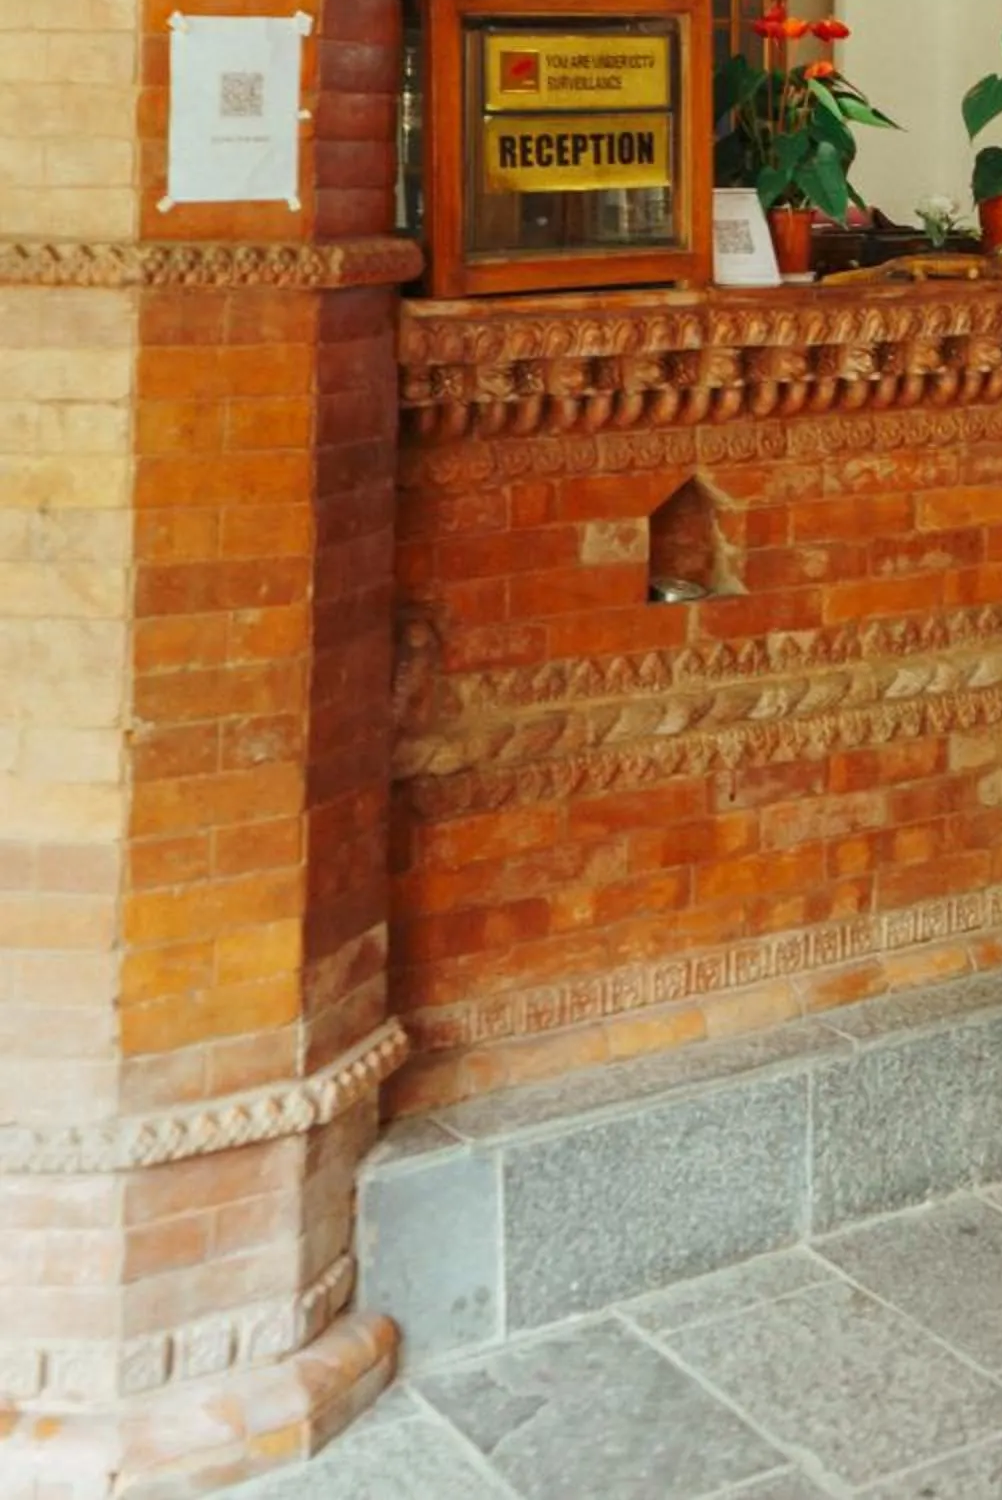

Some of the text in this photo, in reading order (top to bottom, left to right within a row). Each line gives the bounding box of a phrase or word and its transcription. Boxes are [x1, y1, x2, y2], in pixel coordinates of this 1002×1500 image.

[546, 55, 568, 68] YOU
[571, 55, 589, 68] ARE
[499, 132, 654, 169] RECEPTION
